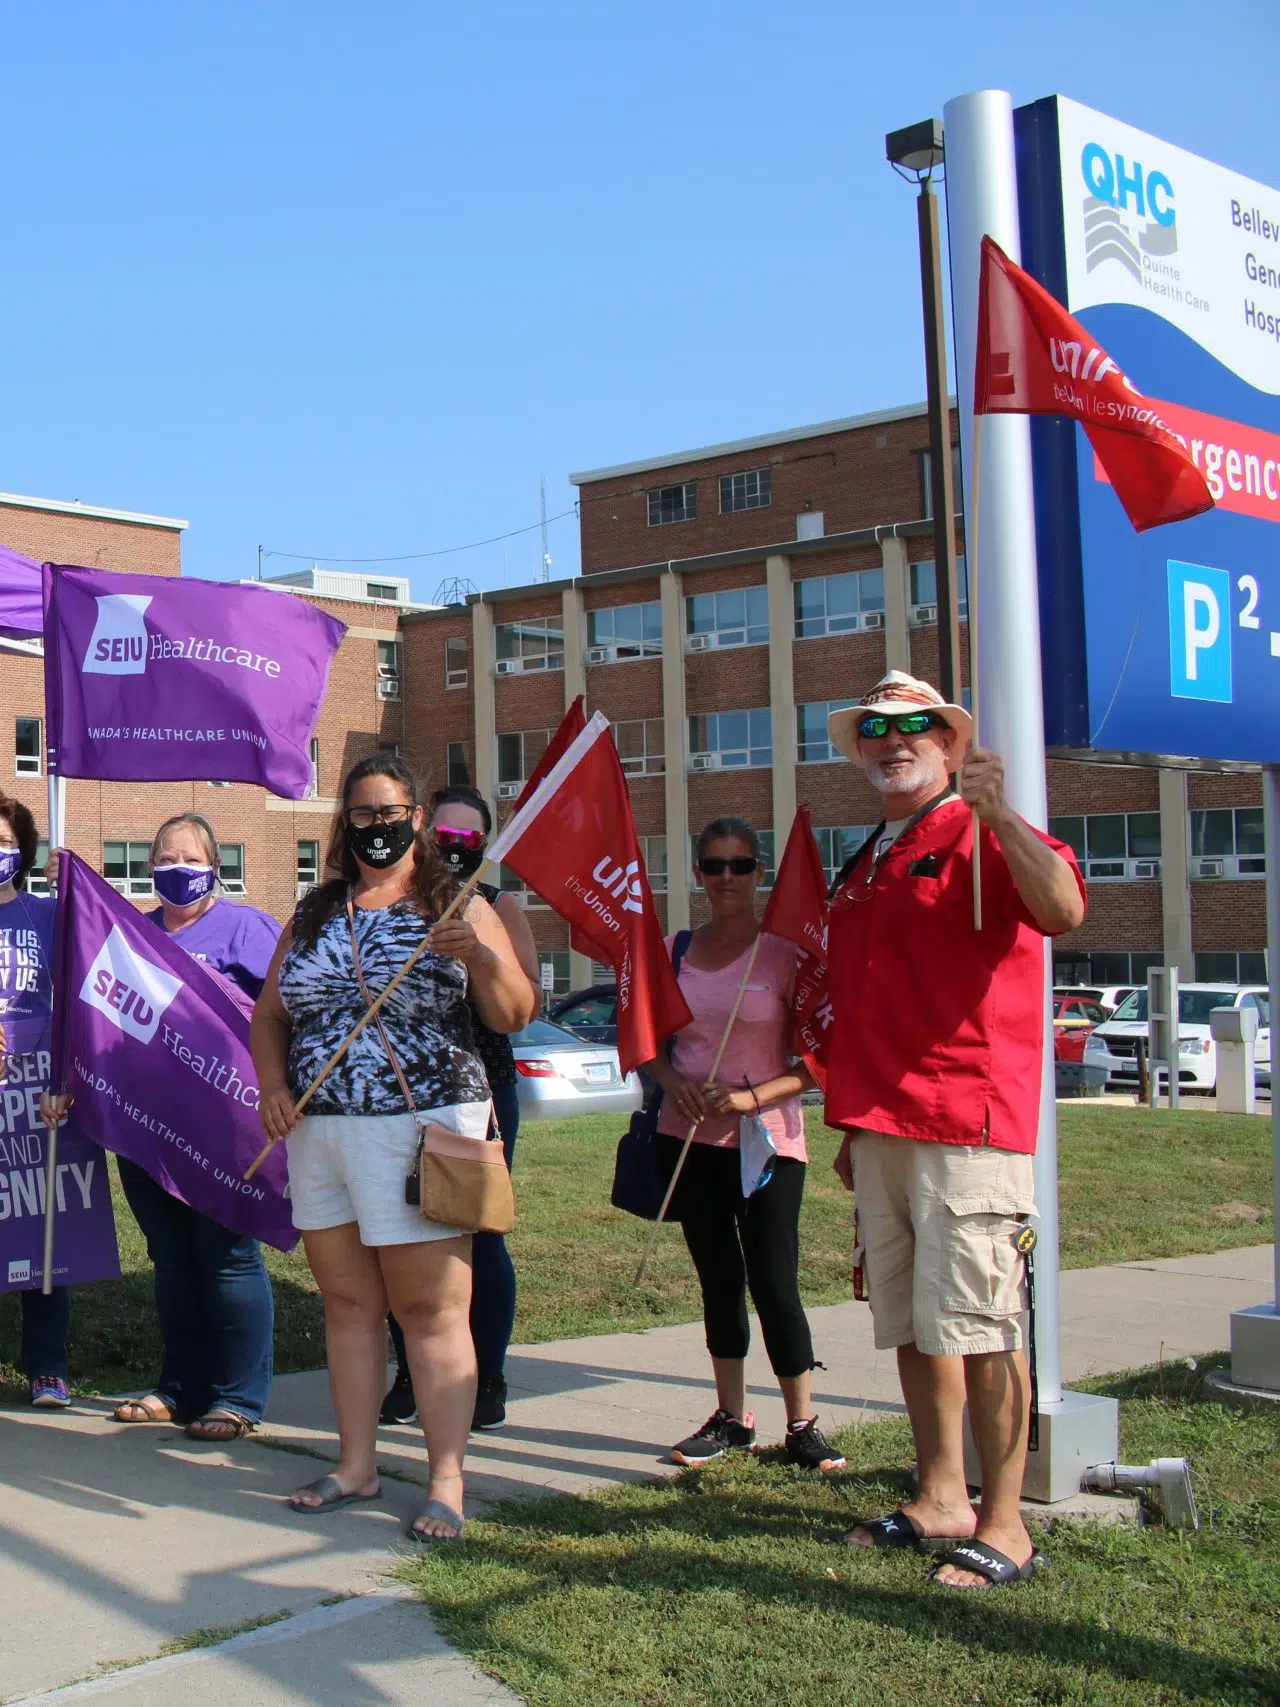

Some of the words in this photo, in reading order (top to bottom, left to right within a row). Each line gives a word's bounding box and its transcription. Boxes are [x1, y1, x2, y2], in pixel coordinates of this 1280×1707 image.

[1081, 142, 1176, 227] QHC
[1142, 255, 1181, 281] Quinte
[1245, 252, 1280, 290] Gen
[1143, 276, 1183, 304] Health
[1185, 291, 1210, 313] Care
[1237, 574, 1261, 629] 2
[1183, 580, 1220, 681] P
[94, 636, 143, 663] SEIU
[150, 634, 281, 679] Healthcare
[132, 727, 227, 742] HEALTHCARE
[231, 729, 267, 751] UNION
[564, 874, 621, 932] theUnion
[16, 928, 41, 949] US.
[16, 948, 43, 968] US.
[15, 967, 39, 993] US.
[93, 969, 154, 1026] SEIU
[73, 1056, 121, 1106] CANADA'S
[123, 1103, 209, 1169] HEALTHCARE
[213, 1166, 266, 1201] UNION
[10, 1271, 28, 1280] SEIU
